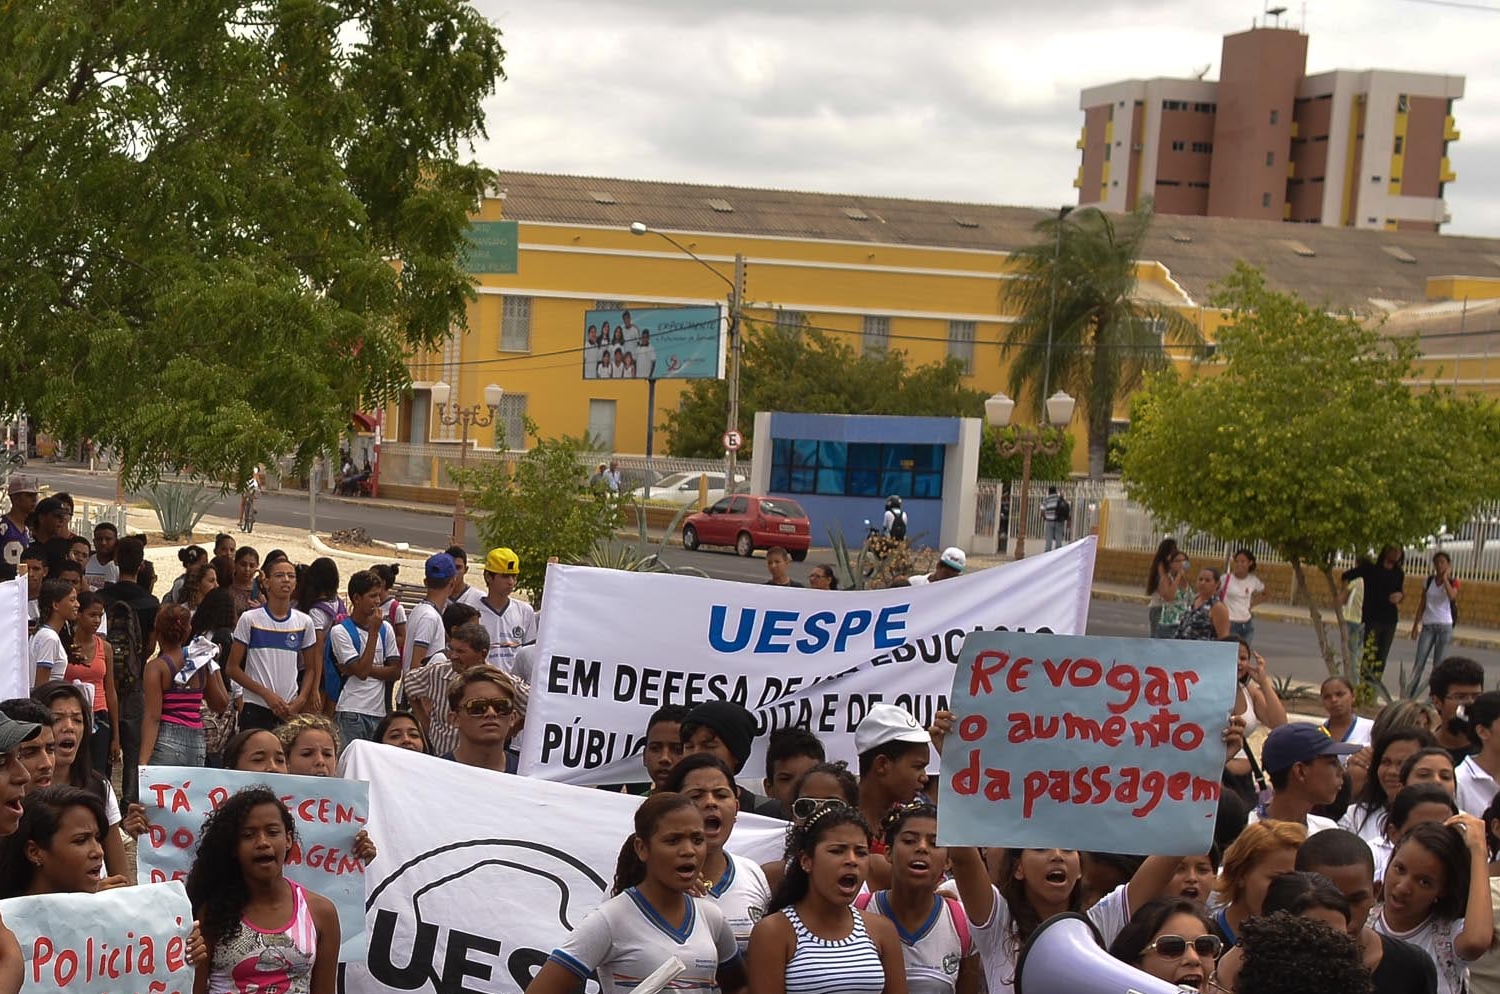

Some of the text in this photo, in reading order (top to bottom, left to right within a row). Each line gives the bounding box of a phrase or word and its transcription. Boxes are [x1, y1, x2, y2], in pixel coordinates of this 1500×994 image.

[708, 603, 911, 654] UESPE
[548, 655, 602, 698] EM
[613, 664, 748, 708] DEFESA
[819, 694, 835, 732] E
[959, 707, 1205, 750] o aumento
[149, 781, 192, 814] TÁ
[951, 749, 1012, 802] da
[149, 825, 195, 849] DO
[33, 931, 155, 987] Policia
